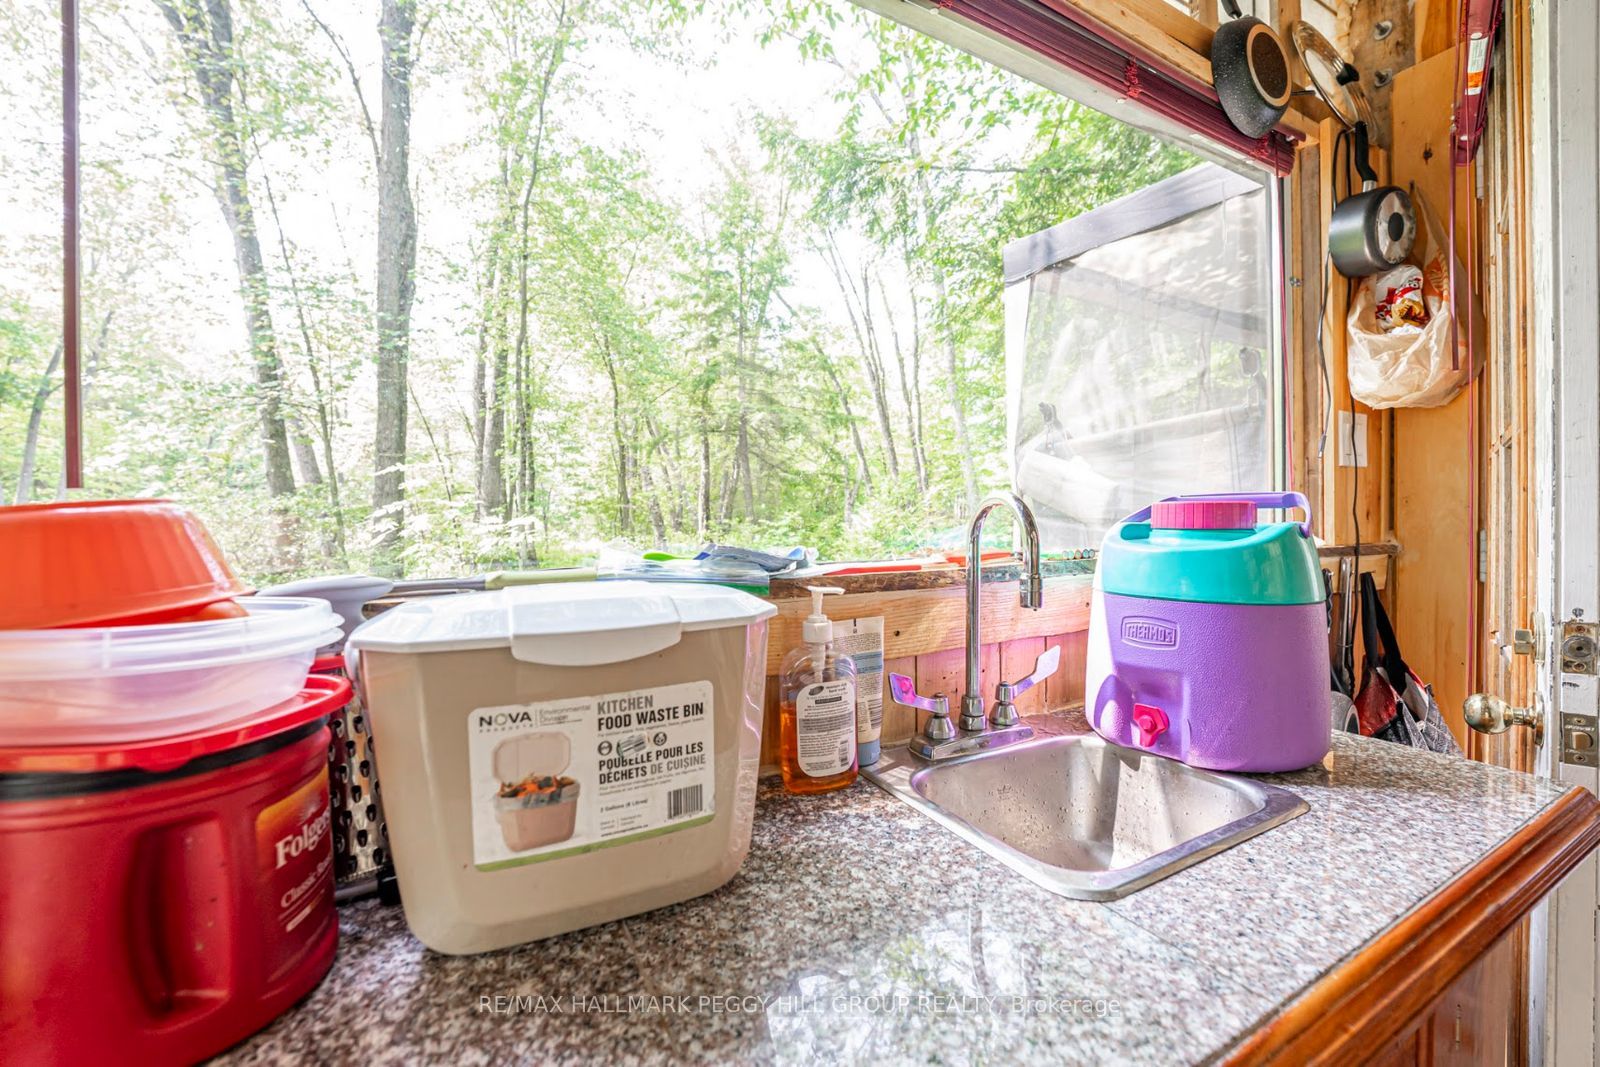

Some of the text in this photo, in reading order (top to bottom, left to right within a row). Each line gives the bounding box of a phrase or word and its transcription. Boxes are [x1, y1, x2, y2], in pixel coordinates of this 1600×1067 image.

[1126, 623, 1173, 644] THERMOS
[597, 695, 654, 716] KITCHEN
[479, 711, 532, 728] NOVA
[598, 713, 632, 732] FOOD
[636, 705, 680, 726] WASTE
[683, 702, 704, 718] BIN
[599, 741, 704, 772] POUBELLE POUR LES
[650, 762, 664, 776] DE
[666, 753, 706, 773] CUISINE
